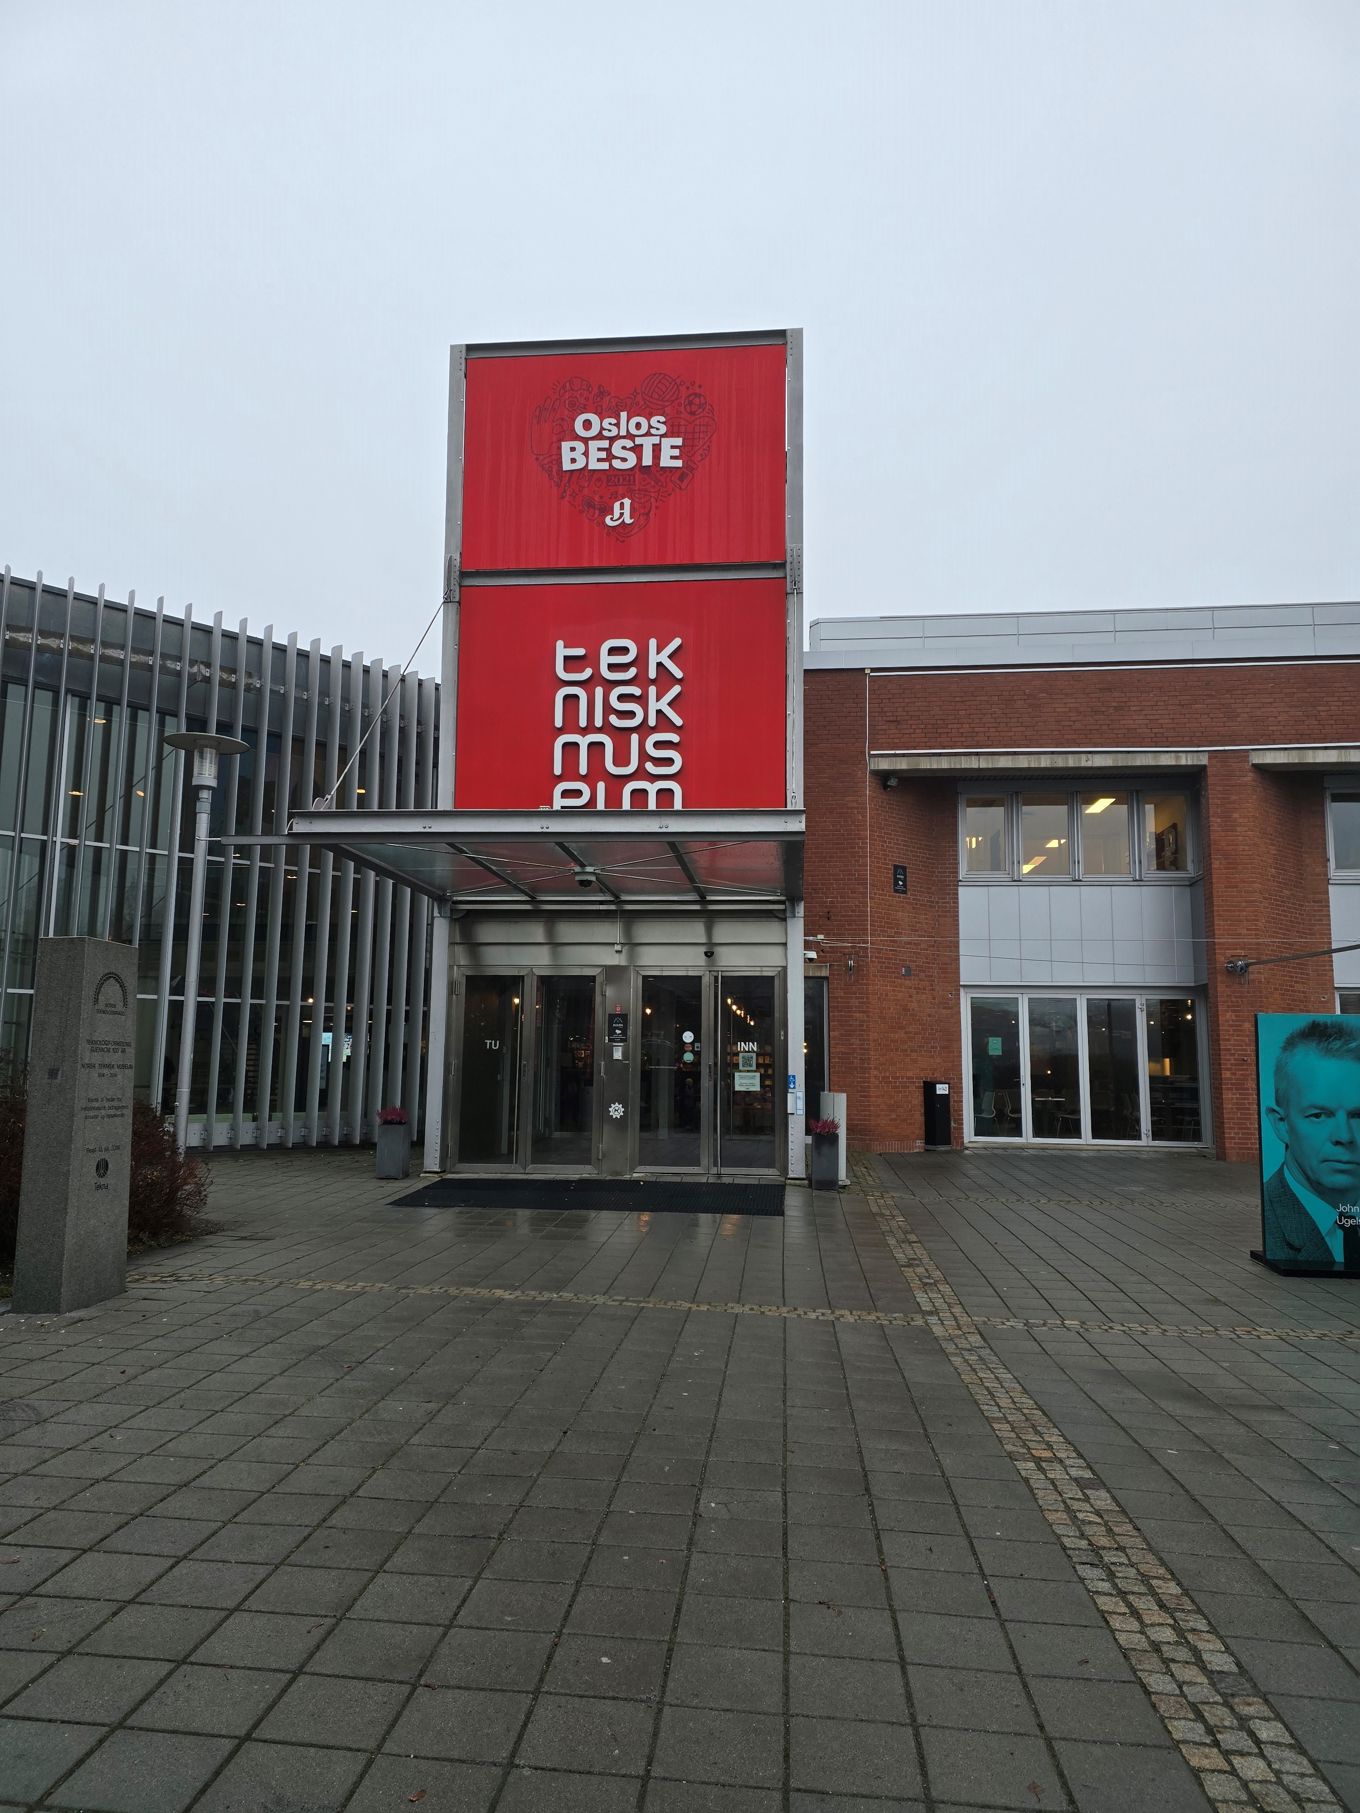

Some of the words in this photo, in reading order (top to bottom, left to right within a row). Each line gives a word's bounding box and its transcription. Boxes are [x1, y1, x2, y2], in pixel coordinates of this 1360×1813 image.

[574, 411, 667, 438] Oslos
[561, 436, 683, 471] BESTE
[737, 1041, 757, 1052] INN
[1336, 1203, 1360, 1213] John
